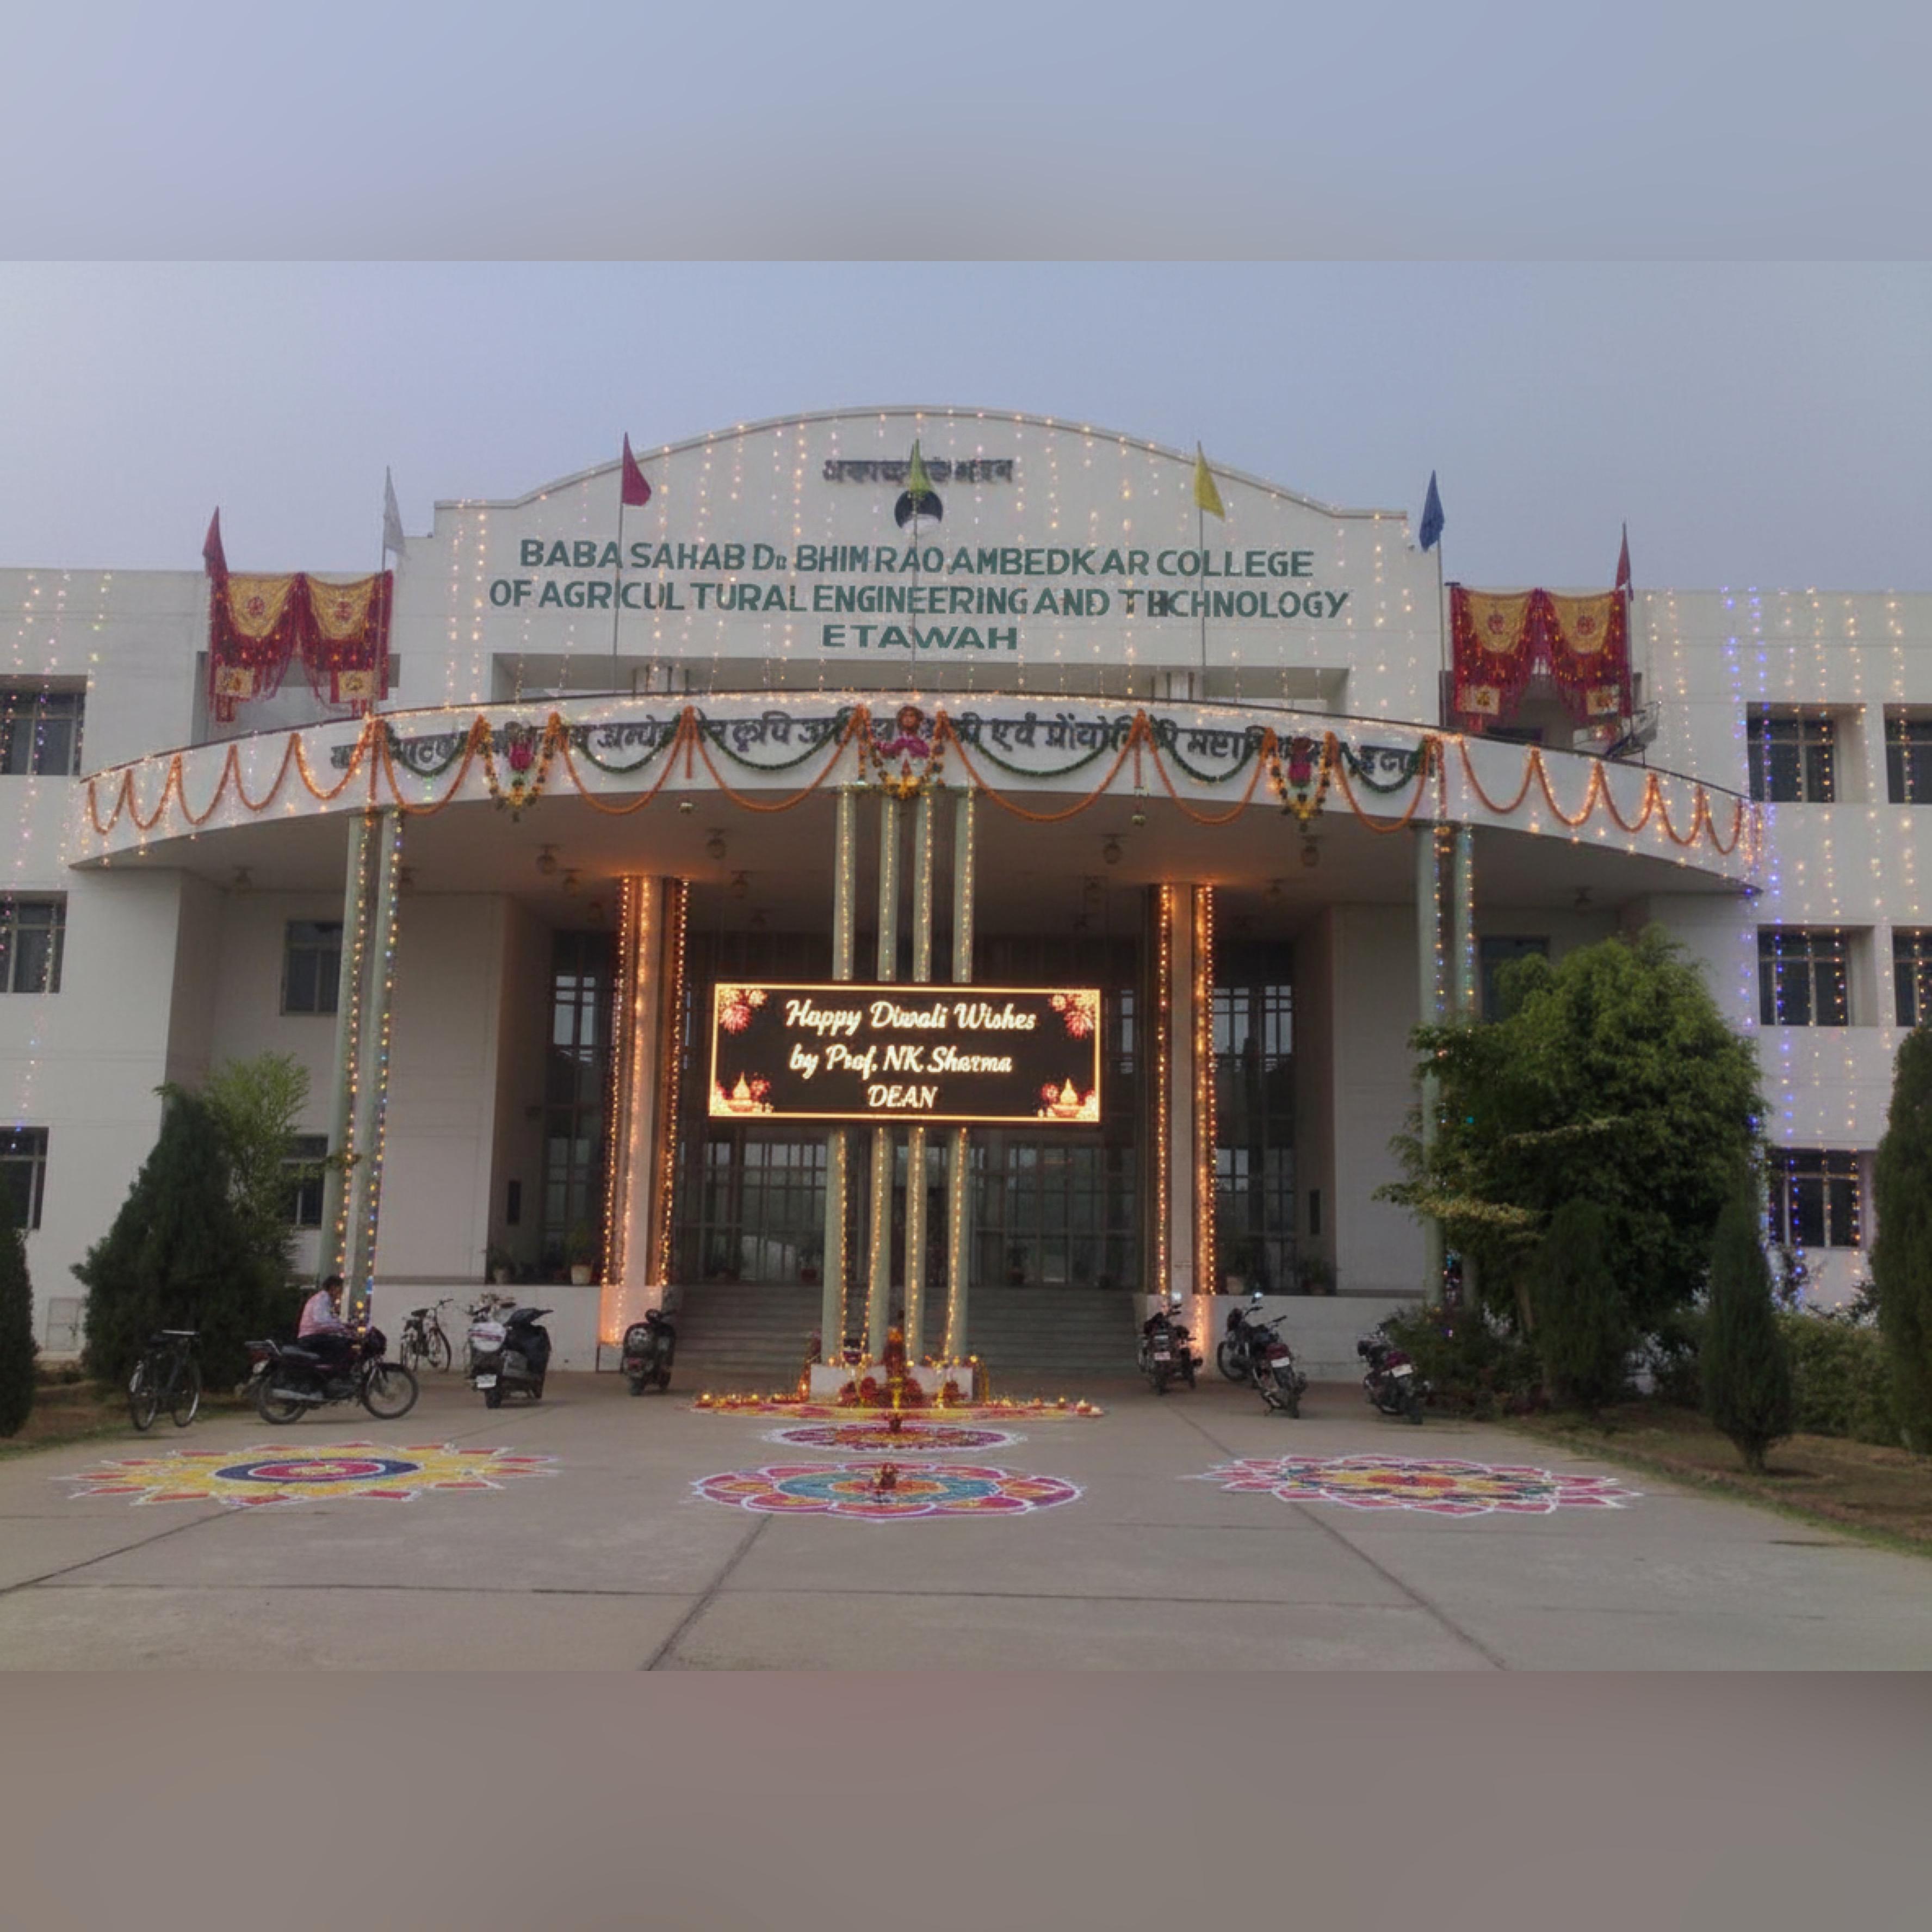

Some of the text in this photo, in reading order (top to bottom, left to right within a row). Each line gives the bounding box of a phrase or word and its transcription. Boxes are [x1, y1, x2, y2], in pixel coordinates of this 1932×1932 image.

[520, 539, 622, 568] BABA
[631, 542, 745, 571] SAHAB
[794, 544, 869, 573] BHIM
[874, 547, 944, 573] RAO
[948, 547, 1149, 576] AMBEDKAR
[1156, 549, 1314, 577] COLLEGE
[490, 579, 532, 608] OF
[538, 580, 806, 612] AGRICULTURAL
[813, 584, 1027, 615] ENGINEERING
[1032, 587, 1111, 616] AND
[823, 624, 1017, 649] ETAWAH
[991, 711, 1037, 752] एवं
[785, 999, 1037, 1036] Happy Diwali Wishes
[789, 1043, 818, 1080] by
[825, 1043, 878, 1081] Prof.
[926, 1045, 1012, 1074] Sharma
[868, 1084, 939, 1109] DEAN
